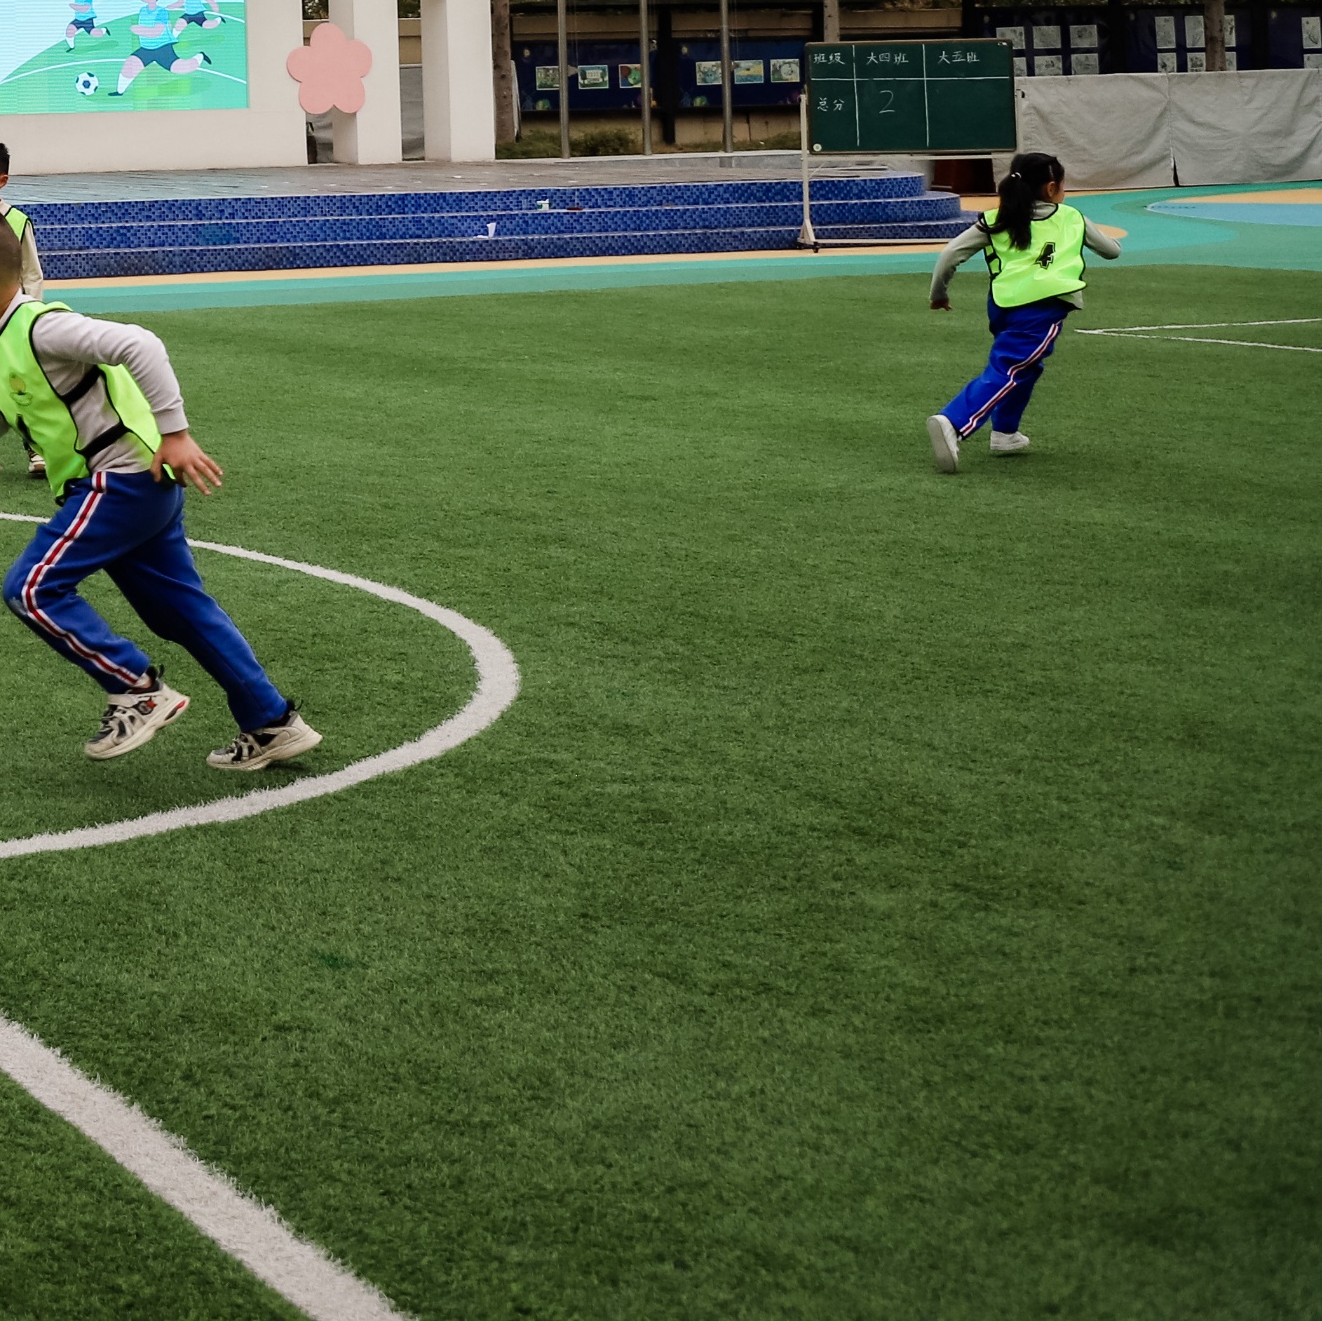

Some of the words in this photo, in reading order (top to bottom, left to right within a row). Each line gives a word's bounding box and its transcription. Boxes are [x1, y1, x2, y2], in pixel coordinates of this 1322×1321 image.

[813, 52, 846, 65] 班级
[866, 51, 910, 65] 大四班
[937, 50, 980, 64] 大五班
[816, 97, 845, 112] 总分
[879, 89, 895, 114] 2
[1035, 242, 1055, 269] 4
